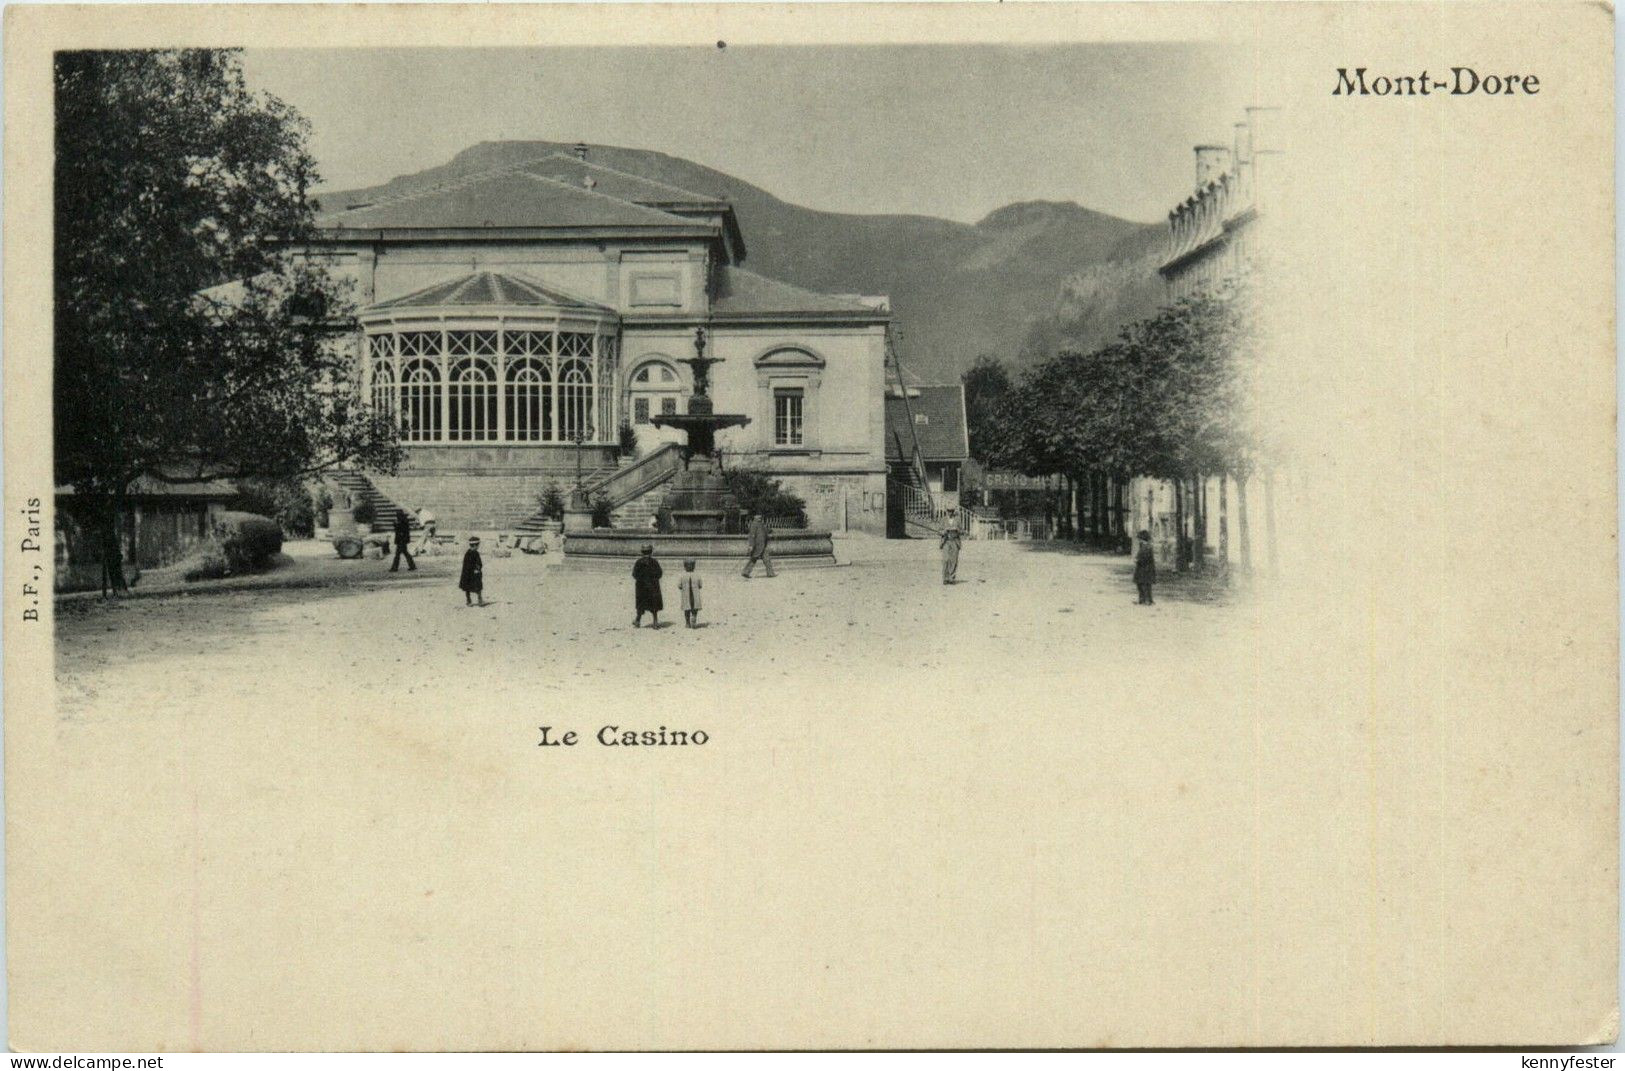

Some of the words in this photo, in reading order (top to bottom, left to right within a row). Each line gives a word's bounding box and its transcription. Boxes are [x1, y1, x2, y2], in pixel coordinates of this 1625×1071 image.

[1332, 67, 1540, 96] Mont-Dore
[21, 497, 41, 553] Paris
[538, 726, 579, 747] Le
[596, 725, 709, 747] Casino
